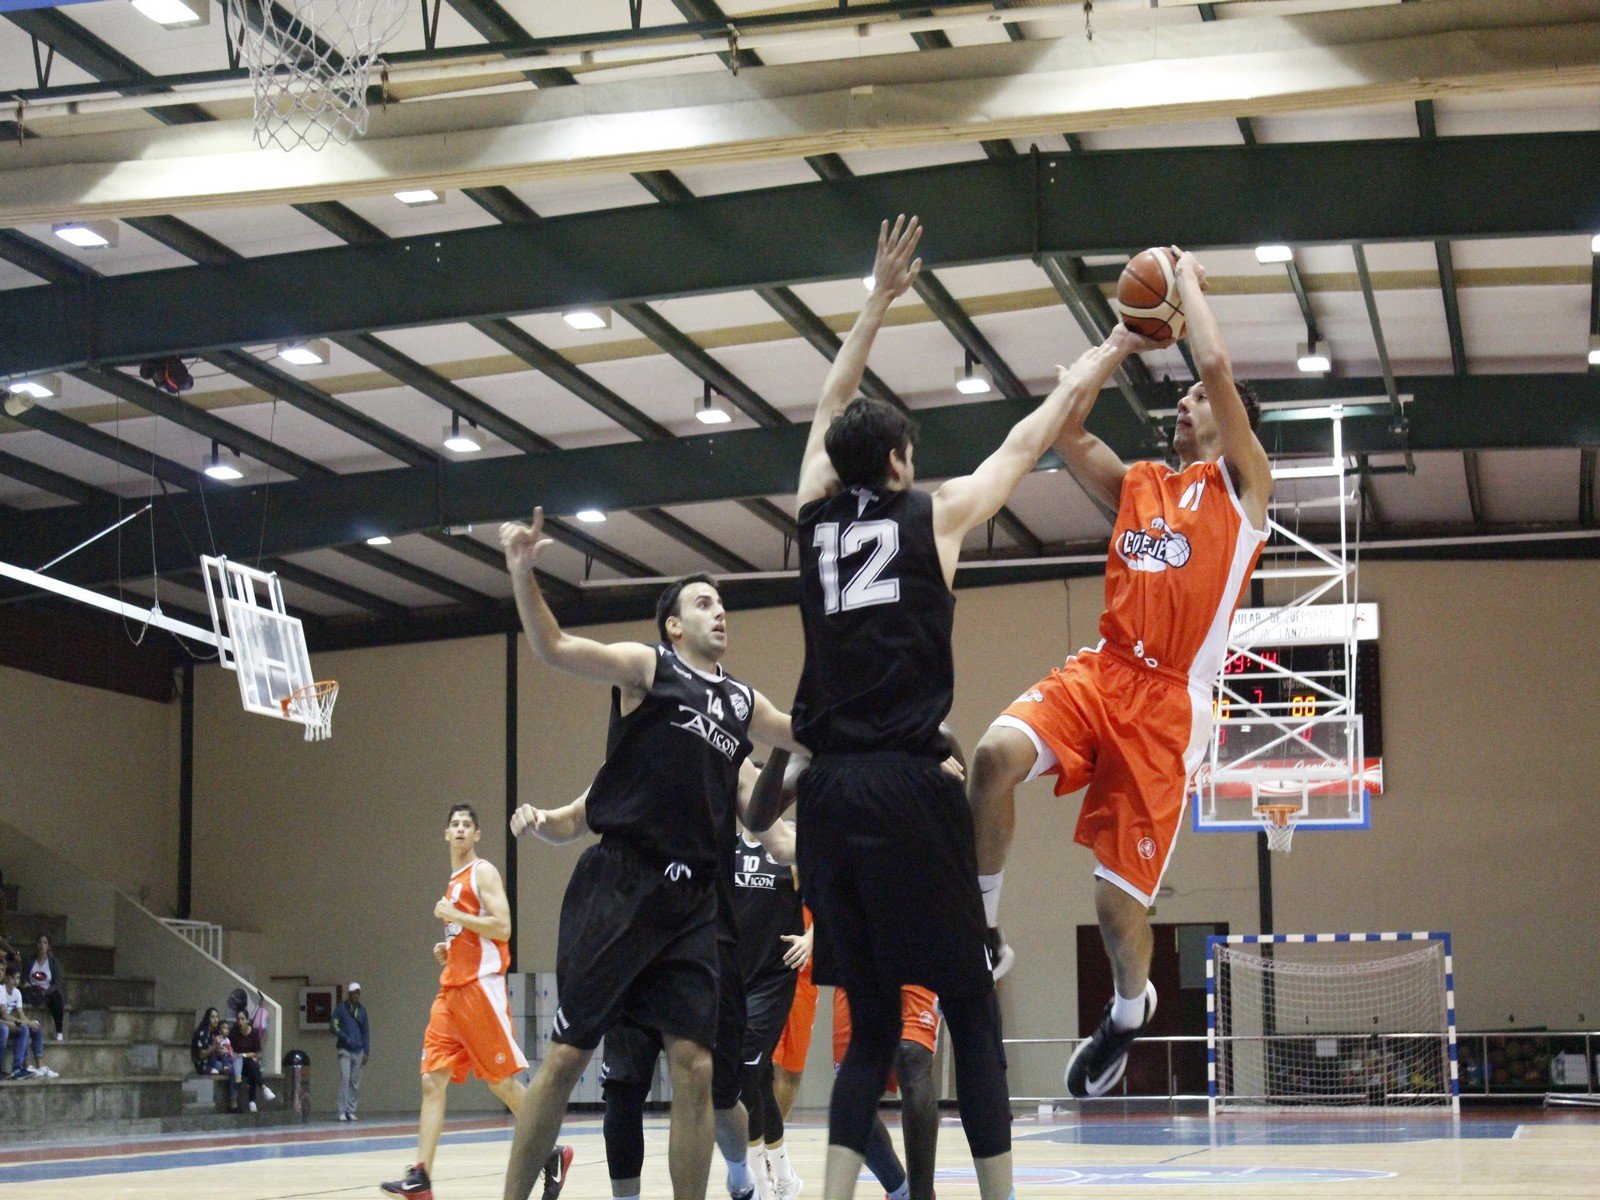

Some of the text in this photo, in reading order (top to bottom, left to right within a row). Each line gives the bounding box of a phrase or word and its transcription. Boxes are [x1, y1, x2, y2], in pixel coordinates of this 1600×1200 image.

[813, 519, 900, 615] 12
[706, 689, 724, 720] 14
[1292, 695, 1316, 717] 00
[743, 855, 760, 872] 10
